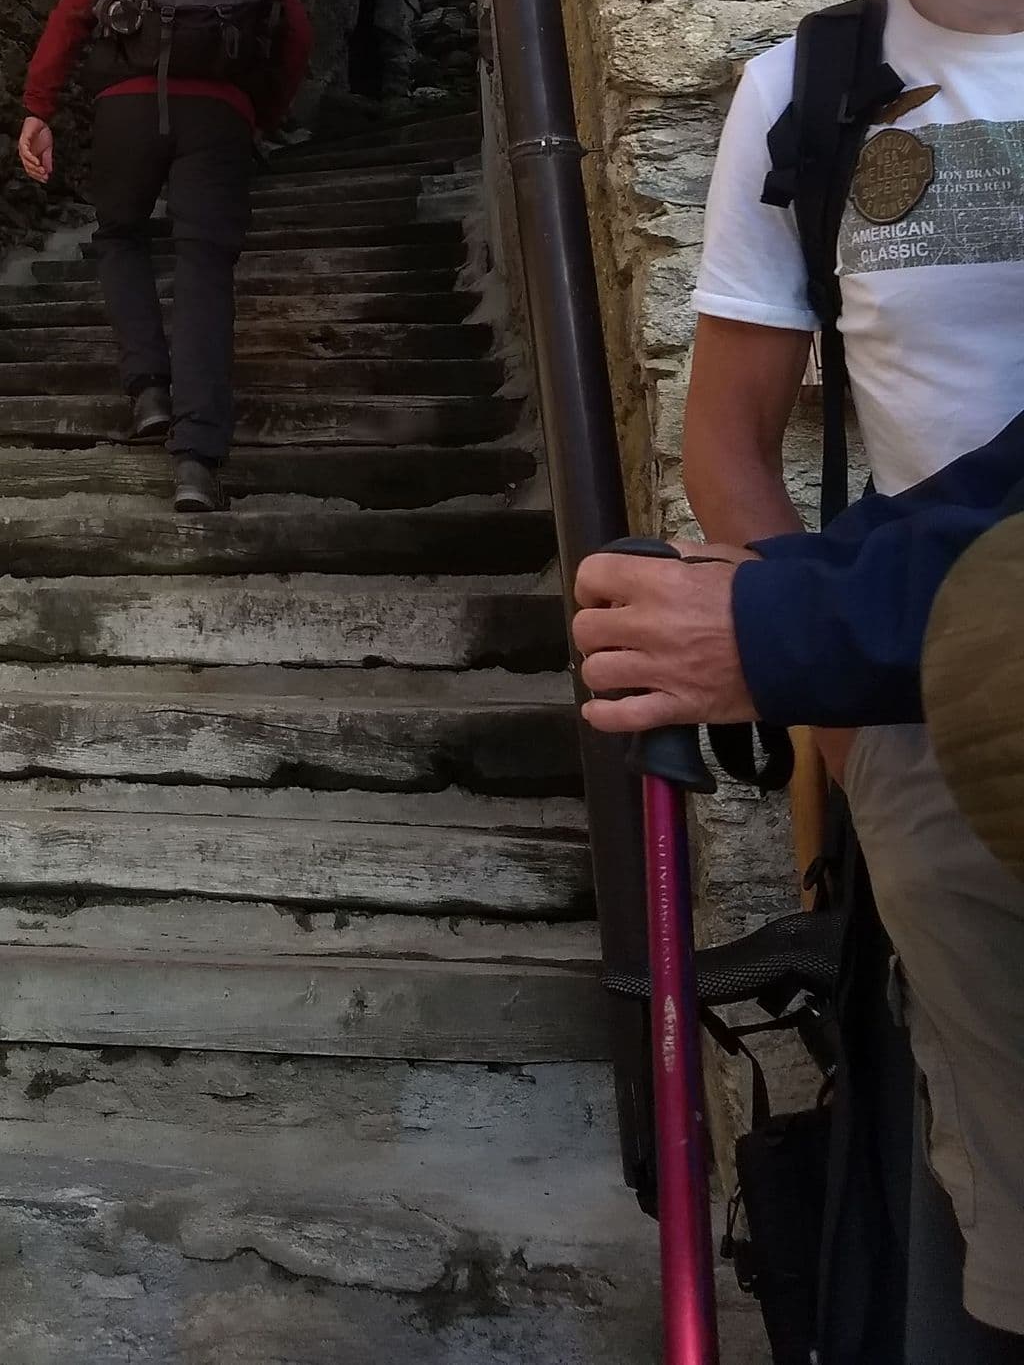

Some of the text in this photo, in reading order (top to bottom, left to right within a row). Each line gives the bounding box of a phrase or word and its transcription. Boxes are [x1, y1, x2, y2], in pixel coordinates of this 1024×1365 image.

[966, 166, 1011, 179] BRAND
[928, 181, 1012, 194] REGISTERED
[851, 220, 935, 245] AMERICAN
[860, 242, 929, 264] CLASSIC
